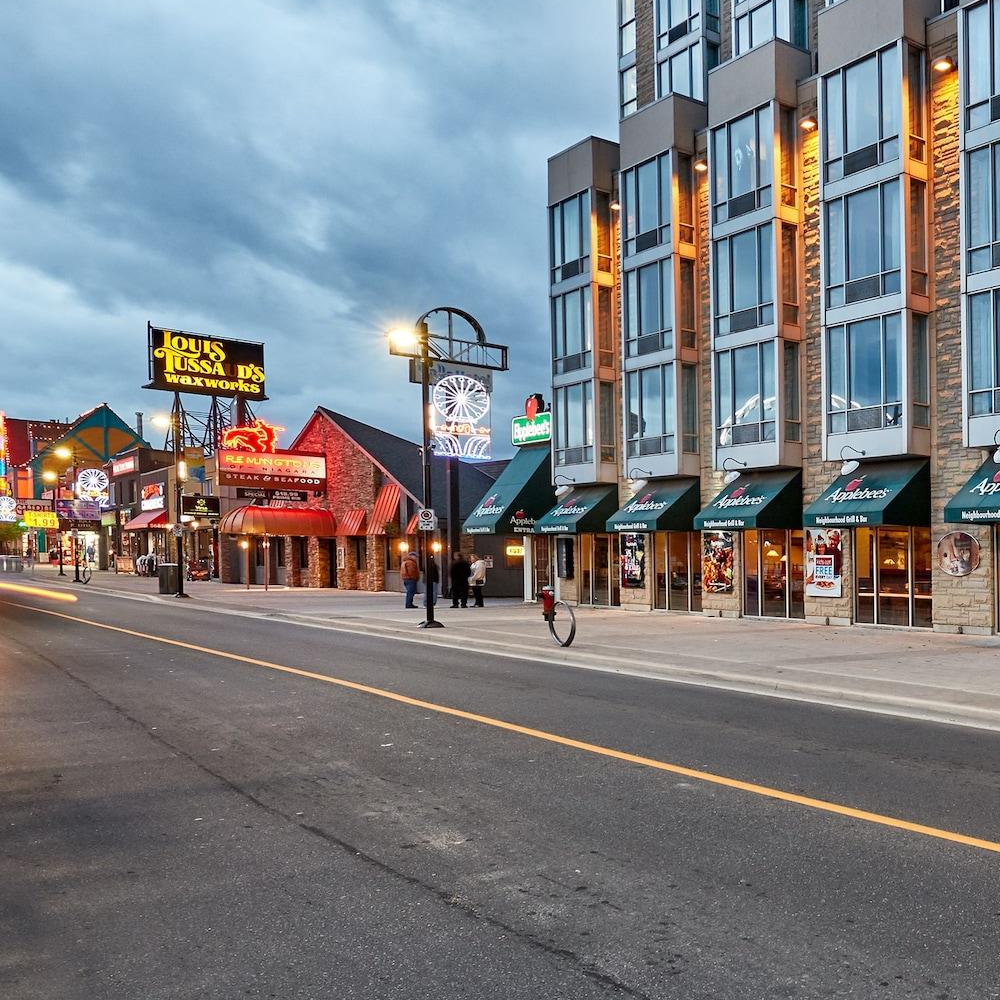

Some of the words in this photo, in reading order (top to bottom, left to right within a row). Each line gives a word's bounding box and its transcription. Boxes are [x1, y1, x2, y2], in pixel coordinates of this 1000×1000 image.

[163, 373, 261, 393] waxworks
[226, 473, 260, 481] STEAK
[274, 477, 321, 485] SEAFOOD
[825, 487, 888, 503] Applebee's
[815, 566, 832, 575] FREE
